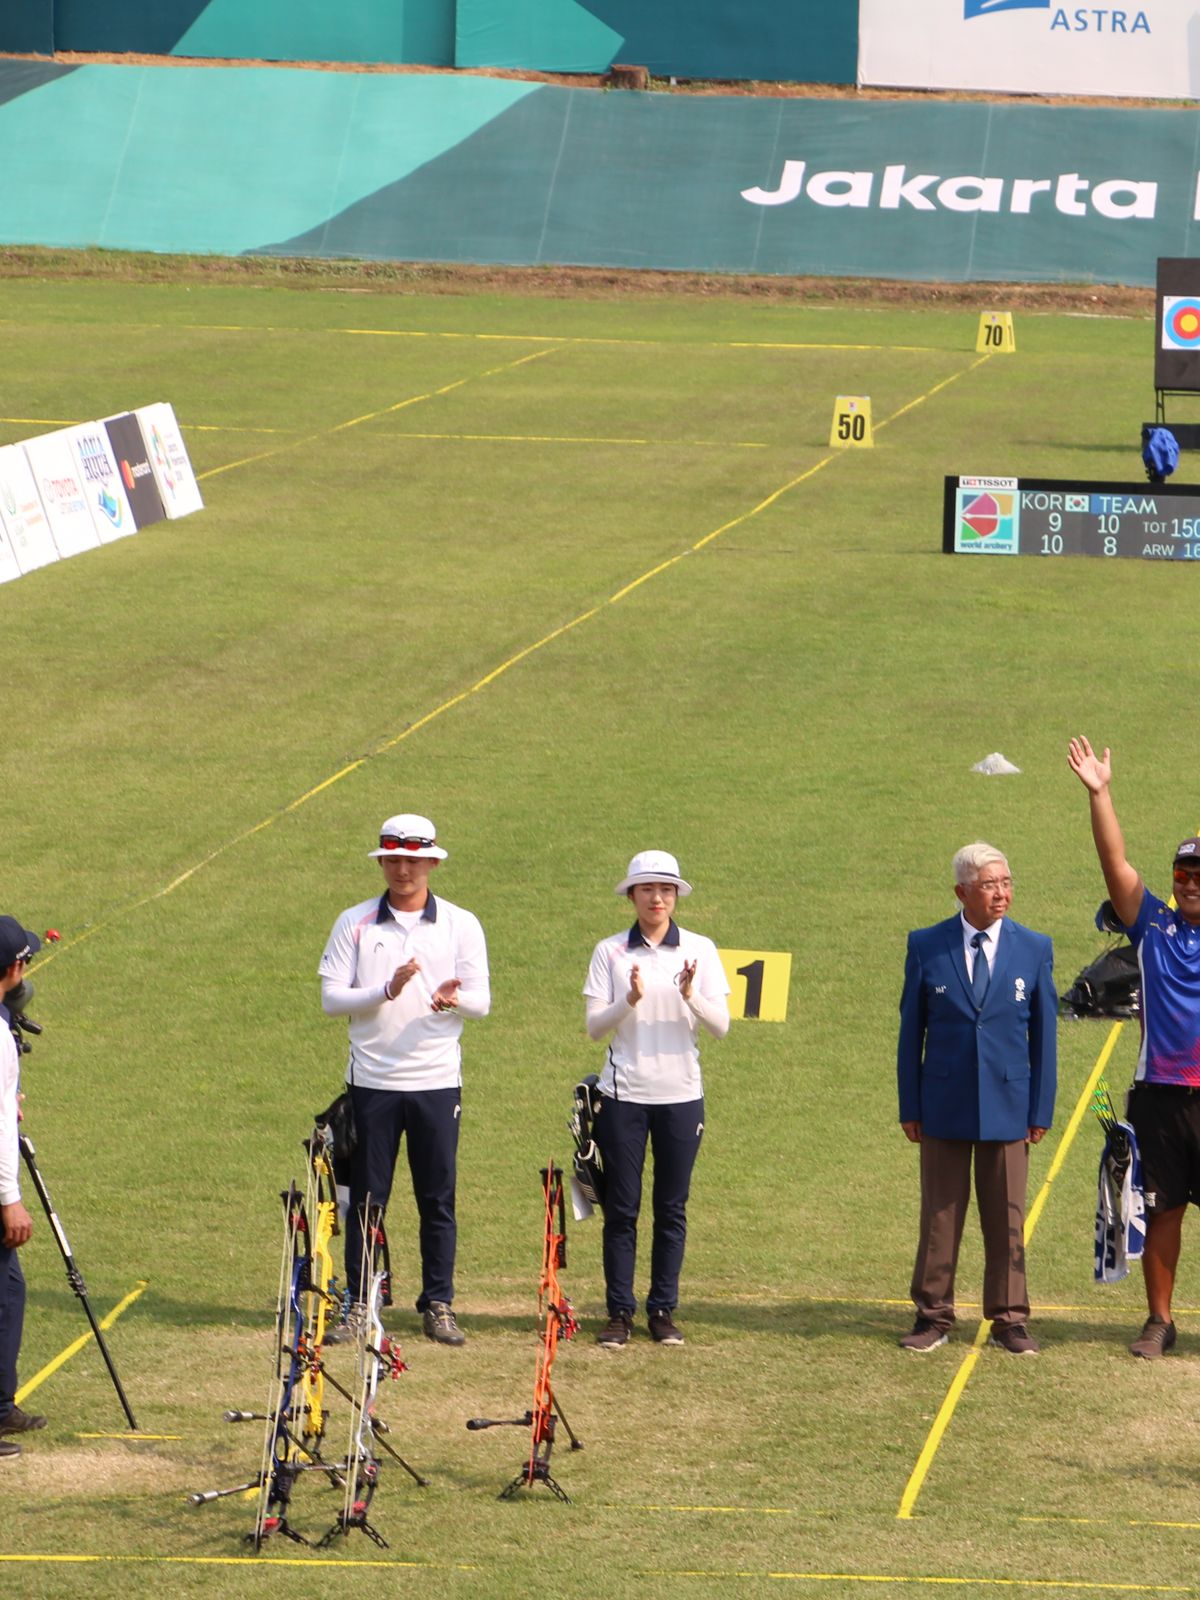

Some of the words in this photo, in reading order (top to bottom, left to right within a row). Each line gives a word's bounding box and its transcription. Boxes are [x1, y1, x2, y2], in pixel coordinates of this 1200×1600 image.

[1050, 8, 1151, 34] ASTRA
[741, 160, 1158, 219] Jakarta
[984, 325, 1003, 346] 70
[838, 414, 865, 441] 50
[977, 479, 1015, 487] TISSOT
[1022, 494, 1063, 511] KOR
[1099, 496, 1158, 514] TEAM
[1048, 513, 1062, 531] 9
[1098, 515, 1120, 534] 10
[1142, 521, 1167, 533] TOT
[1041, 534, 1063, 554] 10
[1103, 536, 1117, 556] 8
[1142, 545, 1175, 556] ARW
[737, 959, 765, 1018] 1
